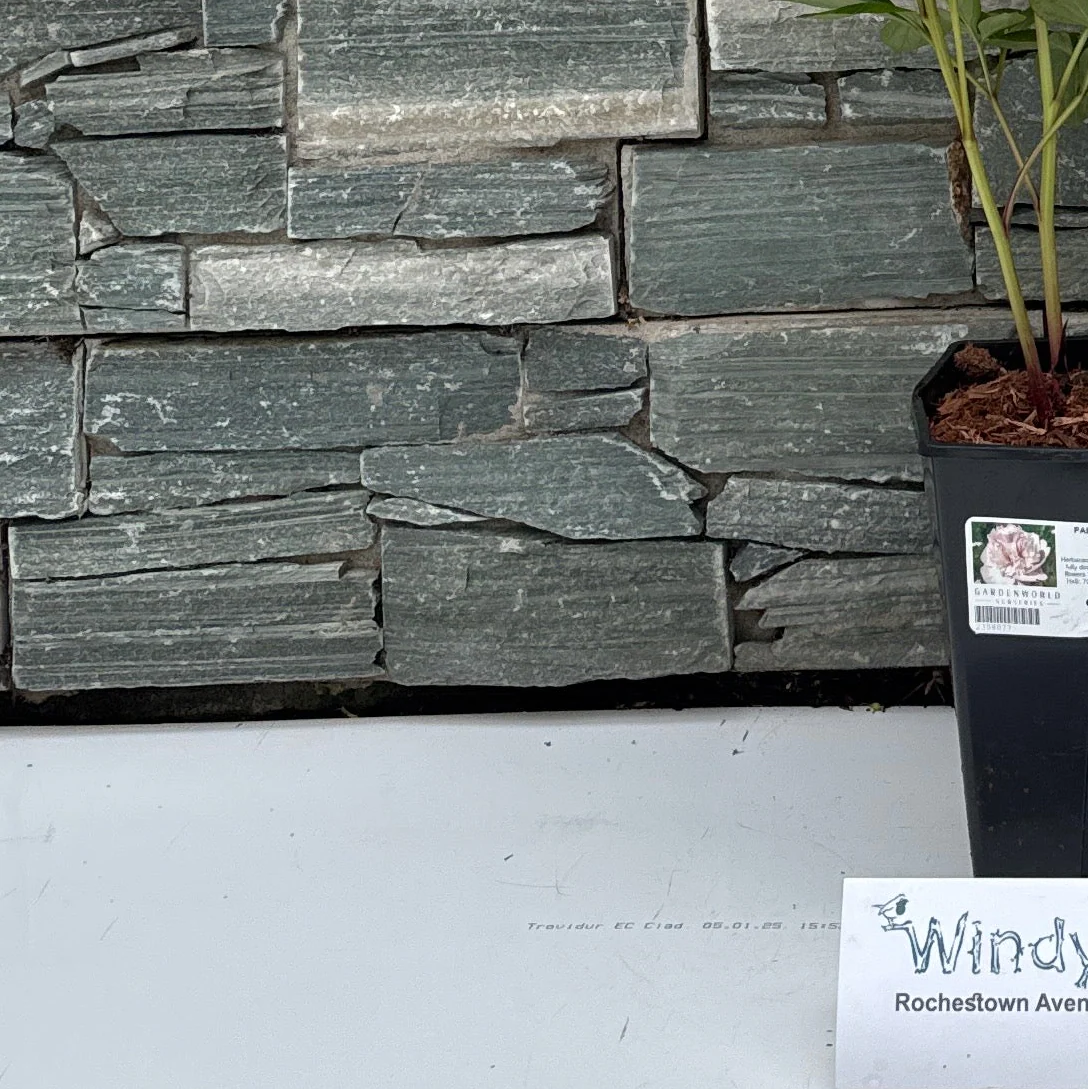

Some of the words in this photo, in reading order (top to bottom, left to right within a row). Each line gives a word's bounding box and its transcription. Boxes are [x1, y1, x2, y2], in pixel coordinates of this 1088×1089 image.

[614, 922, 636, 930] EC
[801, 922, 841, 930] 15:5
[896, 992, 1030, 1013] Rochestown
